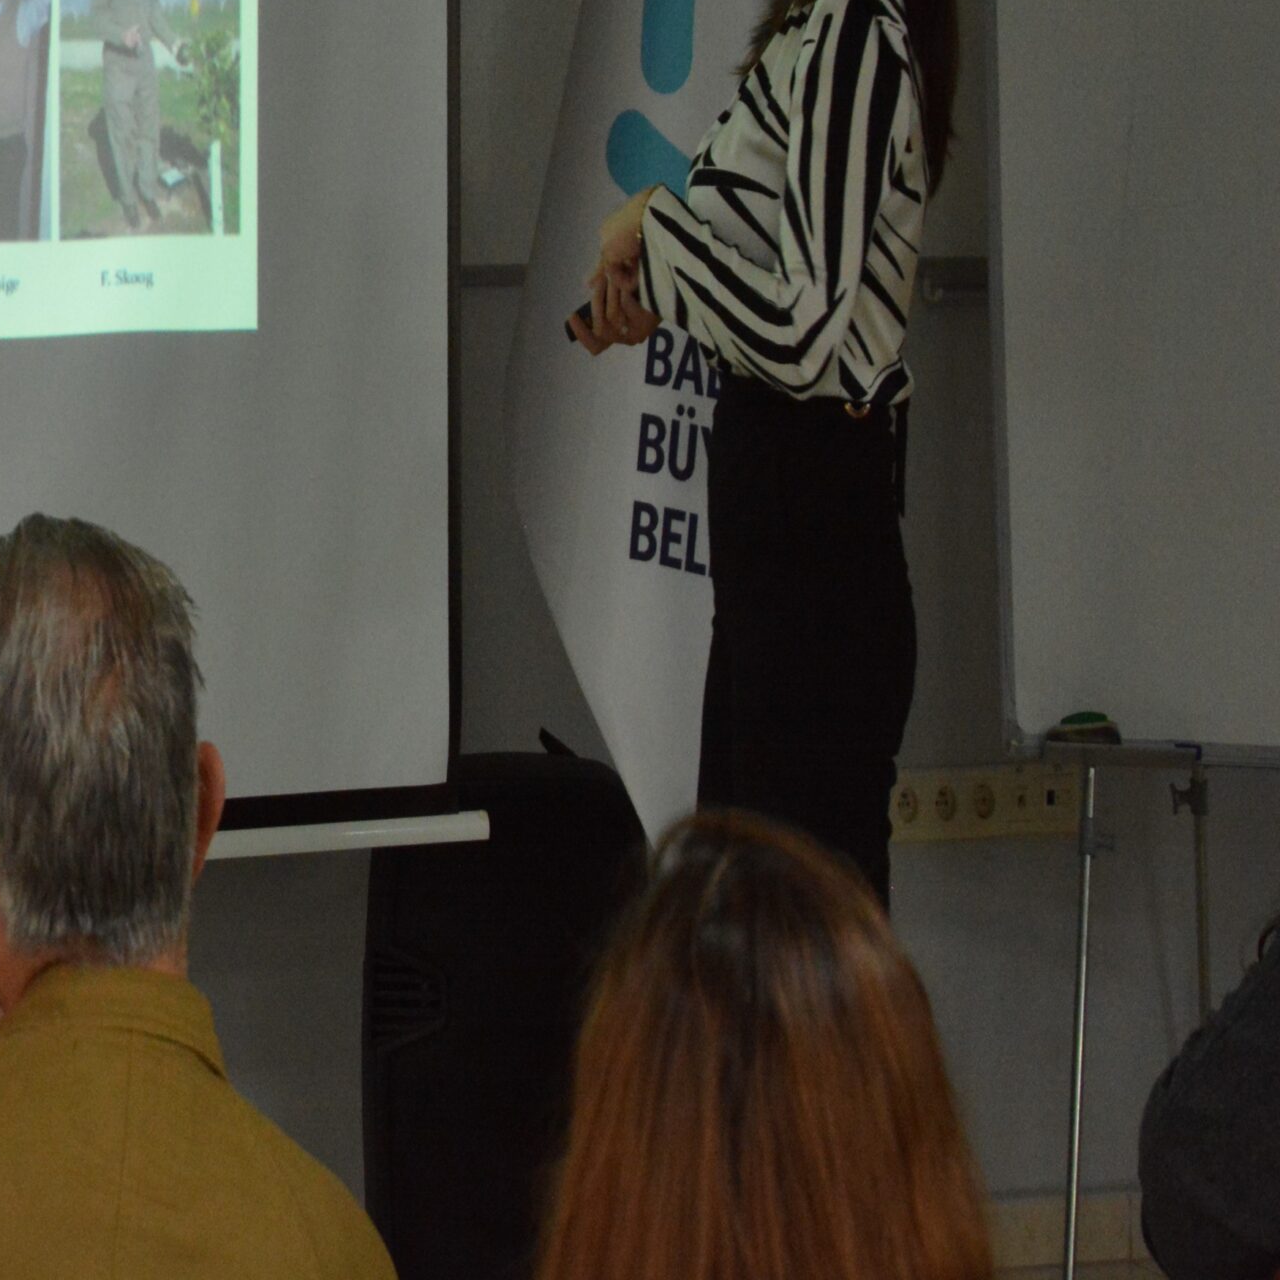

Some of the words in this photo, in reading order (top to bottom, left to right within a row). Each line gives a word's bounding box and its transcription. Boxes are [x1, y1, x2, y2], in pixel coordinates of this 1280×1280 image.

[114, 269, 155, 290] Skoog
[637, 404, 712, 481] BÜ
[629, 500, 713, 577] BEL
